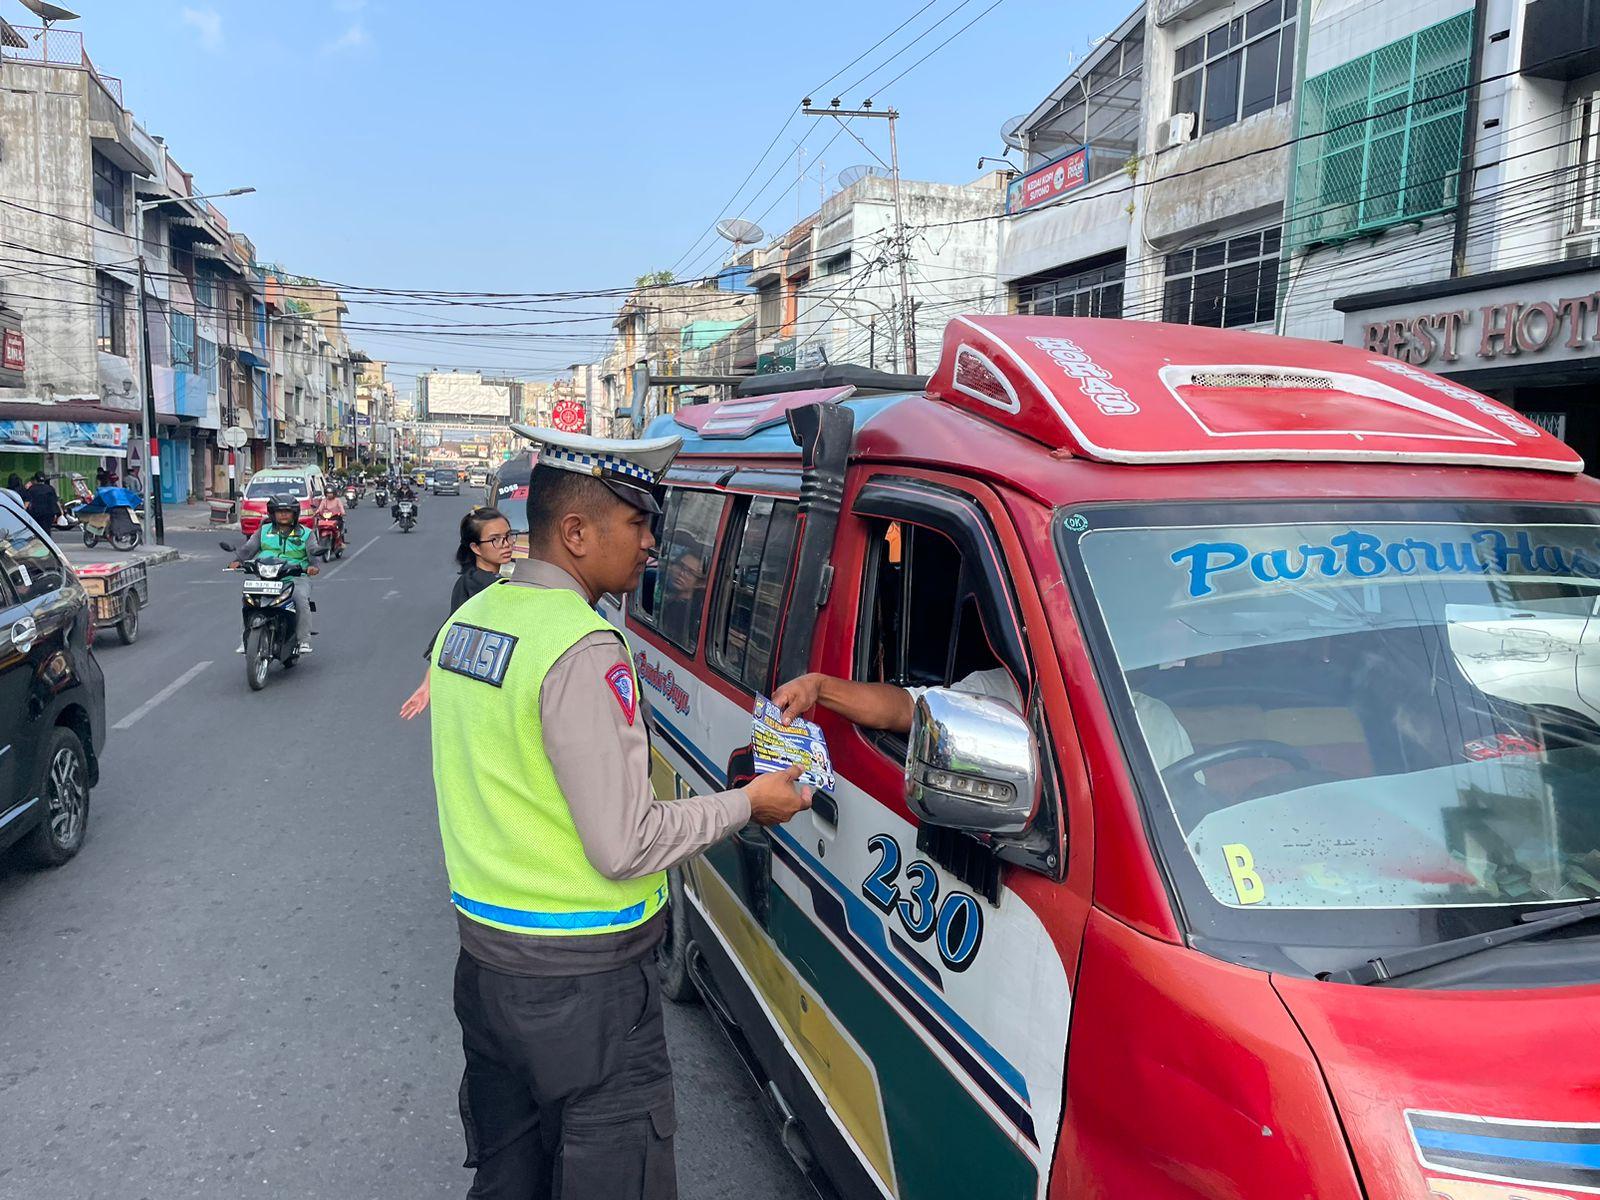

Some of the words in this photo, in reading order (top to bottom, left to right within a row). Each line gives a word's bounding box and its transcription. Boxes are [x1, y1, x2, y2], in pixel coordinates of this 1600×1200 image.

[1027, 177, 1042, 191] KEDAI
[1042, 171, 1054, 185] KOPI
[1363, 309, 1470, 365] BEST
[1476, 290, 1600, 358] HOT
[1025, 336, 1141, 416] HORAS
[556, 401, 581, 413] OPTIK
[498, 483, 519, 495] BOSS
[440, 624, 514, 684] POLISI
[861, 833, 984, 973] 230
[1221, 843, 1265, 906] B
